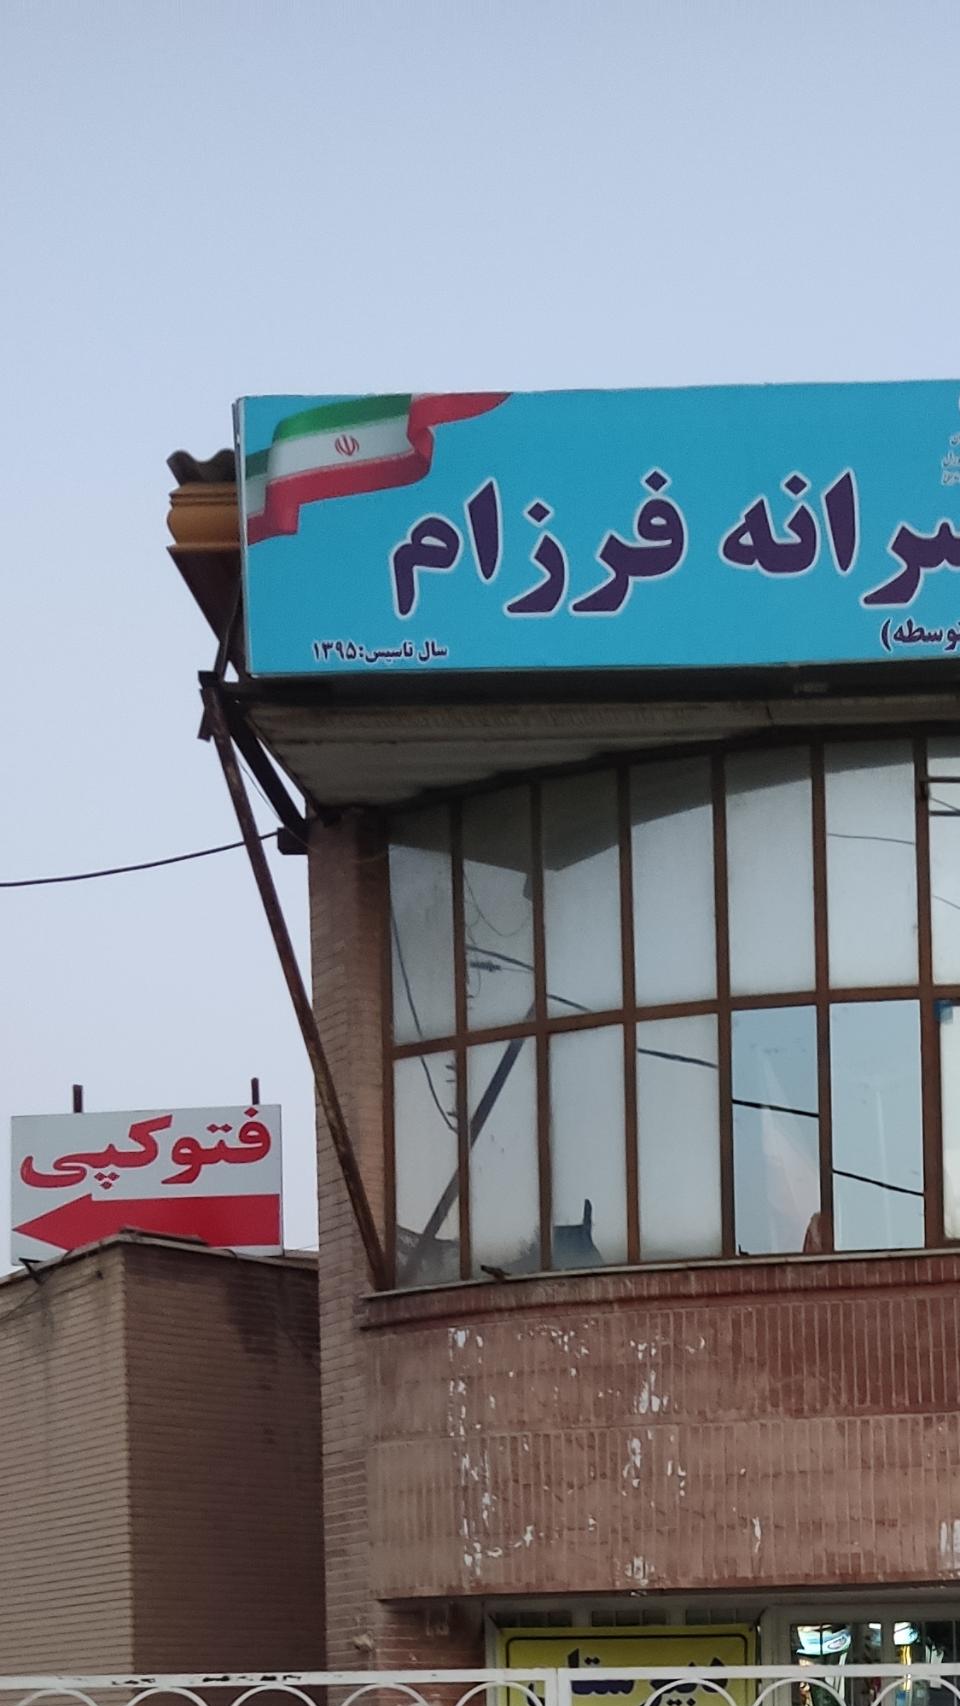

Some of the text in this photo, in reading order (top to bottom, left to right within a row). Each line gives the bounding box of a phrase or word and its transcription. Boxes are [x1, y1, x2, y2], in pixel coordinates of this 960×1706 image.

[391, 472, 686, 616] فرزام
[419, 640, 447, 662] سال
[20, 1106, 272, 1190] فتوکپی
